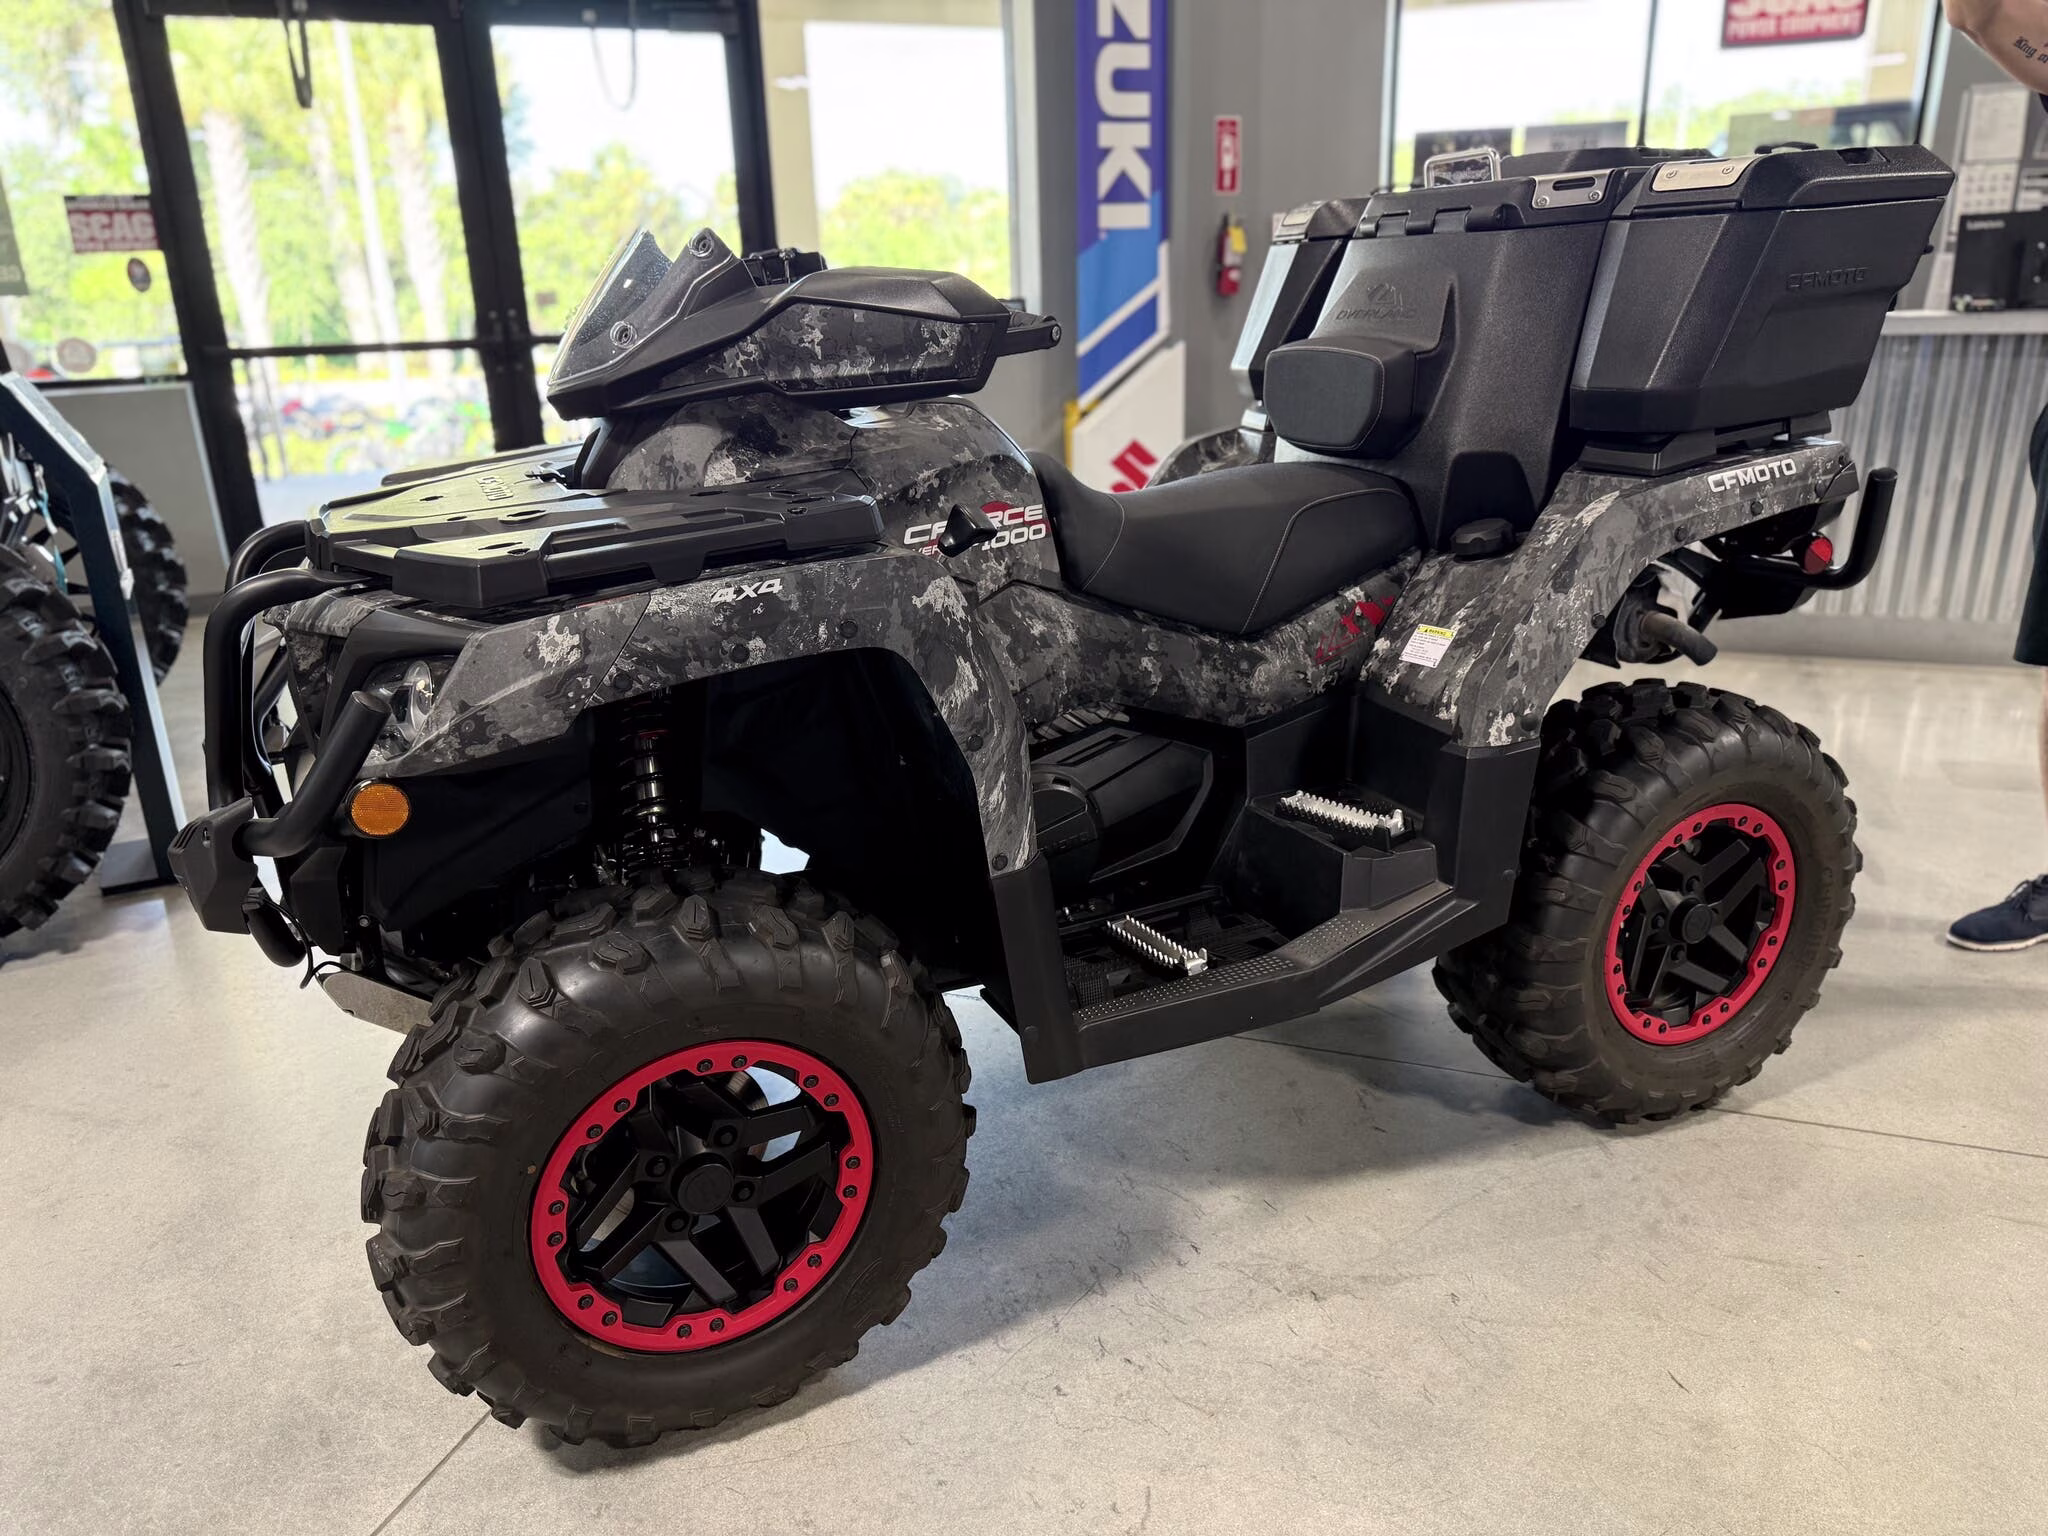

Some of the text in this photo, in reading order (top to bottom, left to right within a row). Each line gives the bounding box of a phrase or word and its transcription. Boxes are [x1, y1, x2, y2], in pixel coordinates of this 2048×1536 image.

[69, 212, 155, 240] SCAG
[1707, 458, 1797, 493] CFMOTO
[903, 504, 1043, 545] CFRCE
